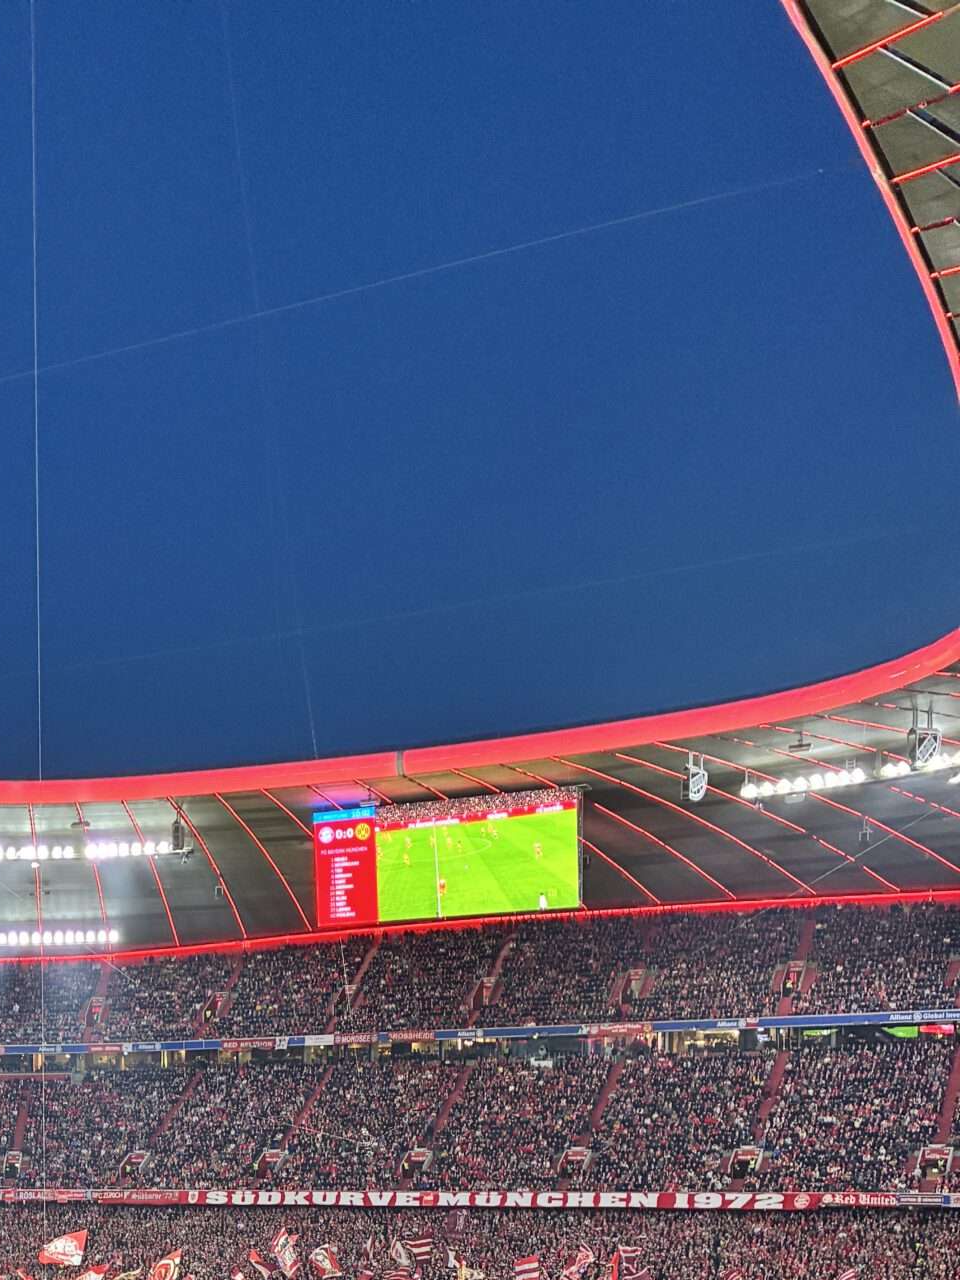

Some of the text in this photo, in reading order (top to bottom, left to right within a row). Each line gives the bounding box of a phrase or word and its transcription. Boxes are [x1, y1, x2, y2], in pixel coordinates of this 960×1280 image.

[889, 1013, 912, 1021] Allianz
[205, 1191, 785, 1209] SÜDKURVE MÜNCHEN 1972
